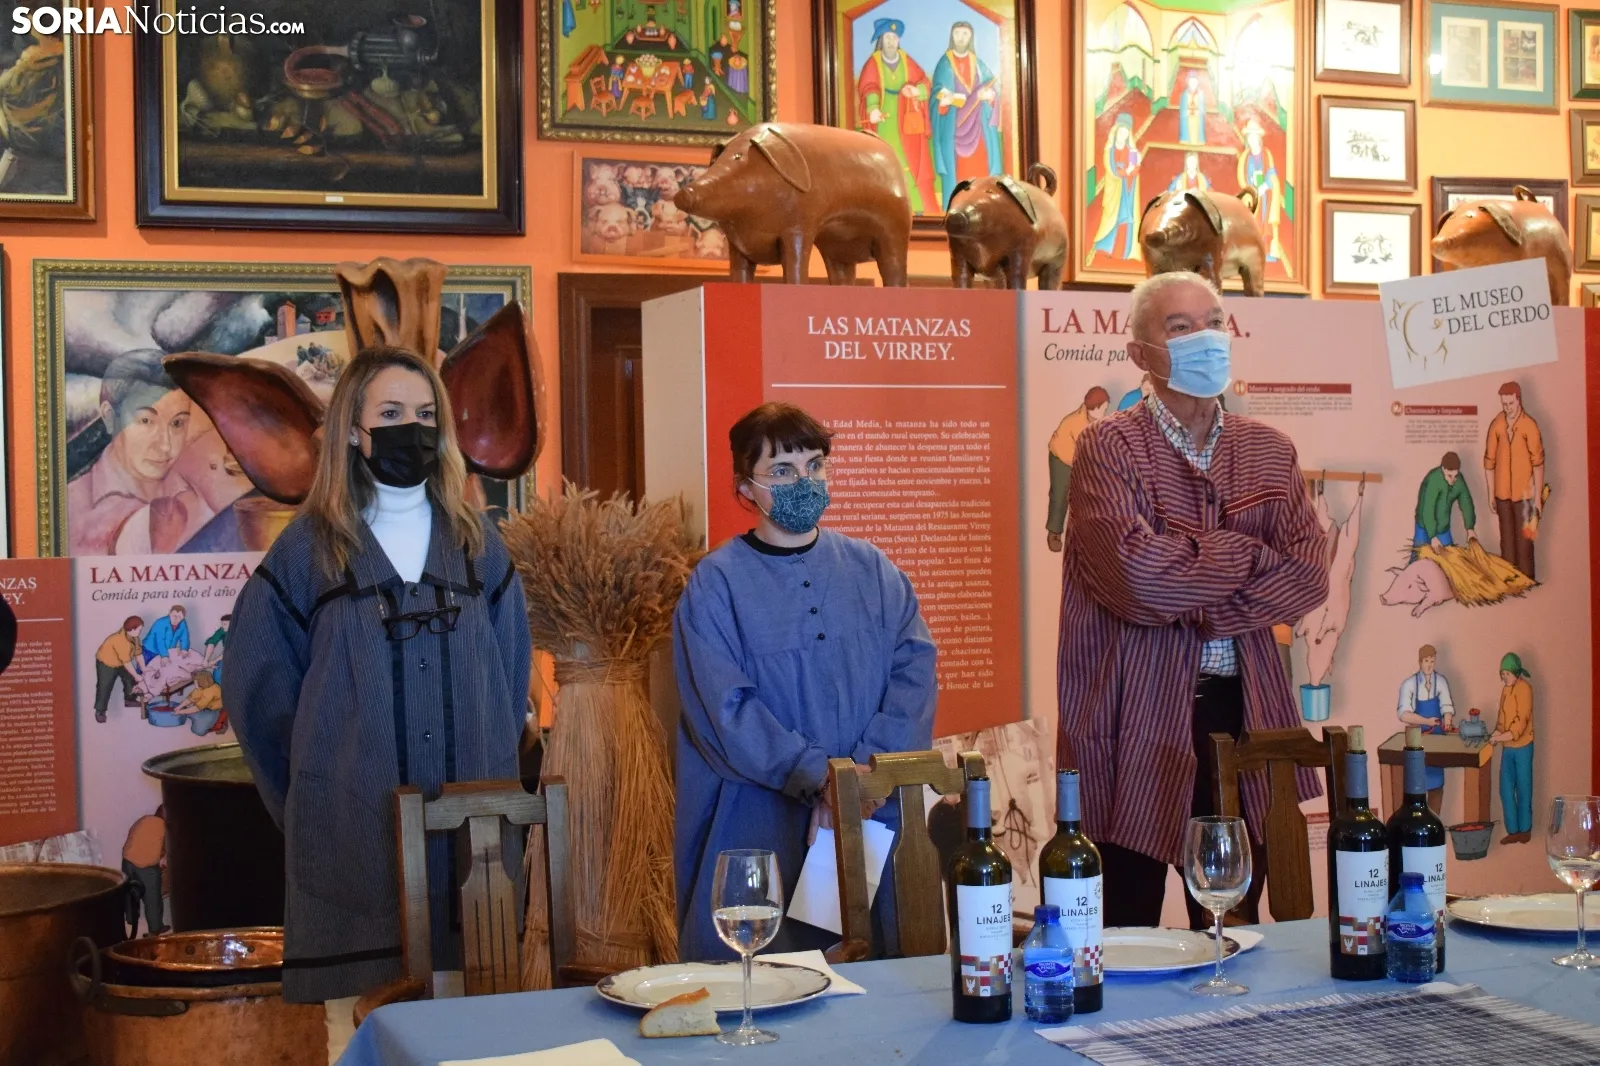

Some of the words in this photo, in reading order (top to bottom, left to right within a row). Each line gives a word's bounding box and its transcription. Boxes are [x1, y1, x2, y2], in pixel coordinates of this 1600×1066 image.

[1433, 296, 1456, 314] EL
[1460, 285, 1523, 310] MUSEO
[808, 317, 848, 335] LAS
[855, 317, 971, 337] MATANZAS
[1042, 308, 1084, 334] LA
[1447, 314, 1484, 335] DEL
[1488, 303, 1550, 328] CERDO
[825, 341, 866, 360] DEL
[873, 342, 955, 361] VIRREY.
[1044, 342, 1102, 362] Comida
[90, 566, 123, 584] LA
[92, 587, 139, 602] Comida
[141, 590, 169, 603] para
[172, 586, 198, 599] todo
[201, 586, 210, 598] el
[214, 586, 236, 597] año
[1368, 868, 1379, 878] 12
[1435, 863, 1442, 872] 12
[1354, 878, 1387, 888] LINAJES
[991, 904, 1002, 914] 12
[1076, 896, 1088, 906] 12
[976, 914, 1010, 924] LINAJES
[1061, 906, 1098, 916] LINAJES
